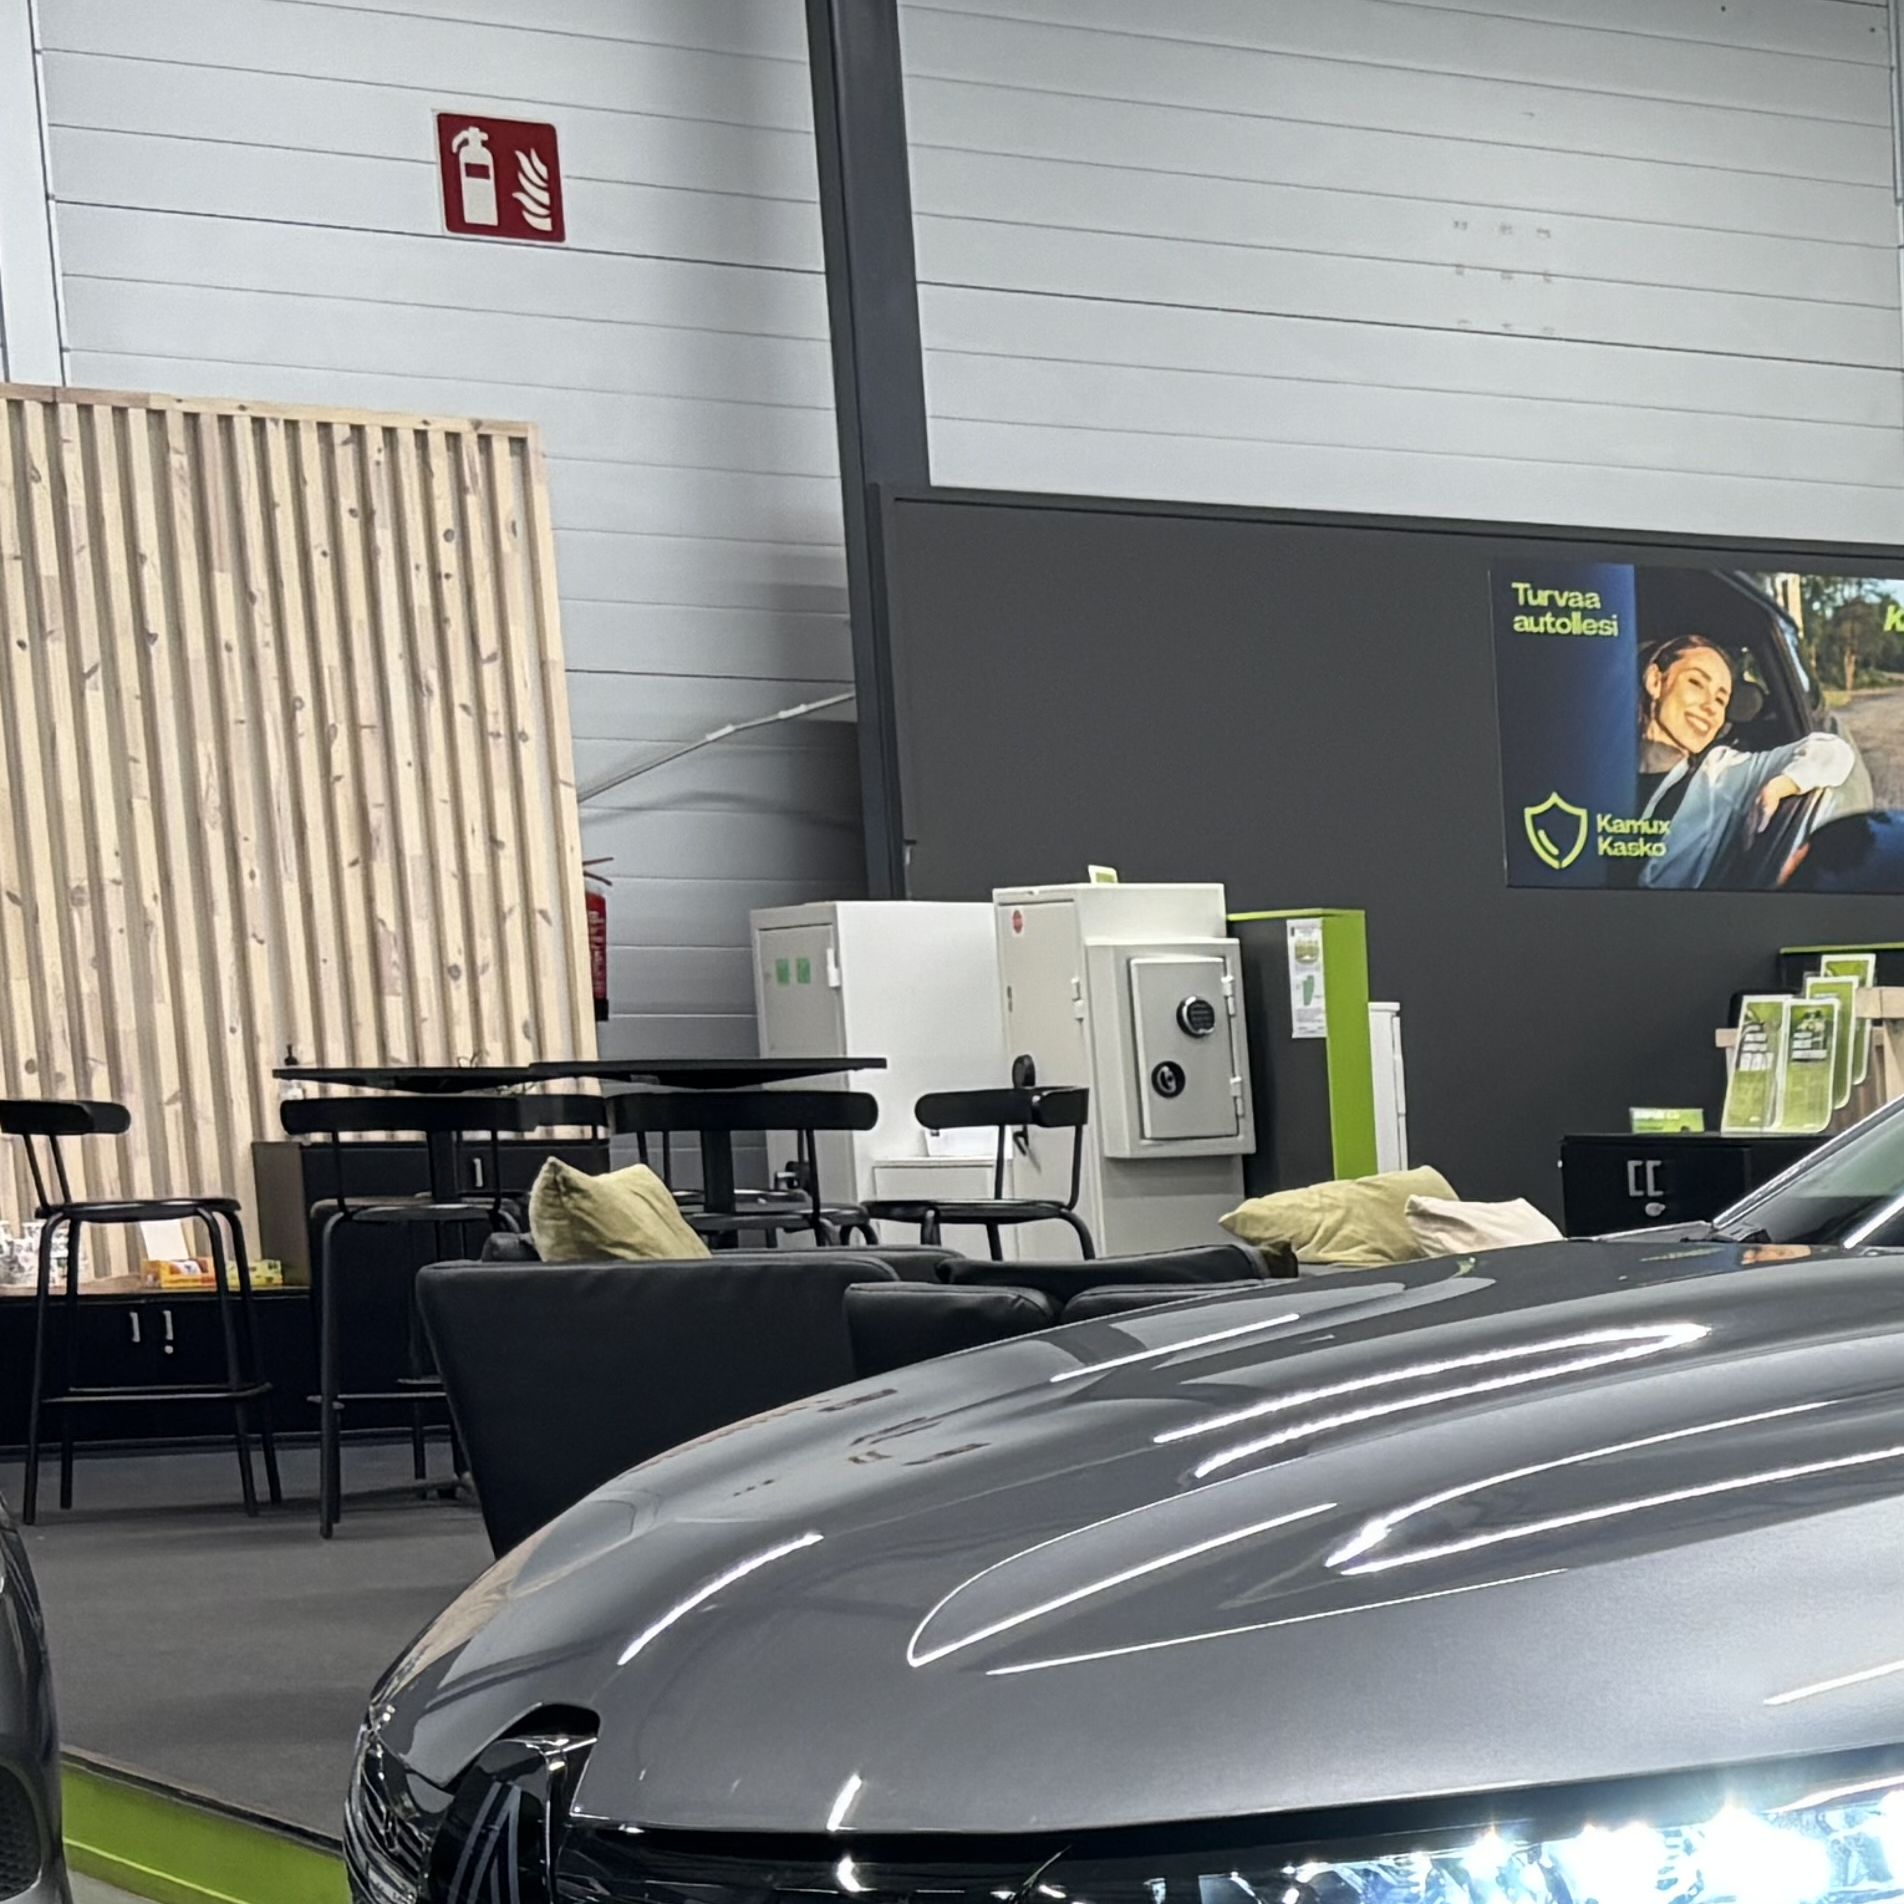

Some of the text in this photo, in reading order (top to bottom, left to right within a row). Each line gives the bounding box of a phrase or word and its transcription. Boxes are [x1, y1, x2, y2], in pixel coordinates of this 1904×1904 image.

[1511, 582, 1602, 609] Turvaa
[1513, 611, 1619, 637] autollesi
[1596, 813, 1671, 835] Kamux
[1598, 836, 1668, 858] Kasko
